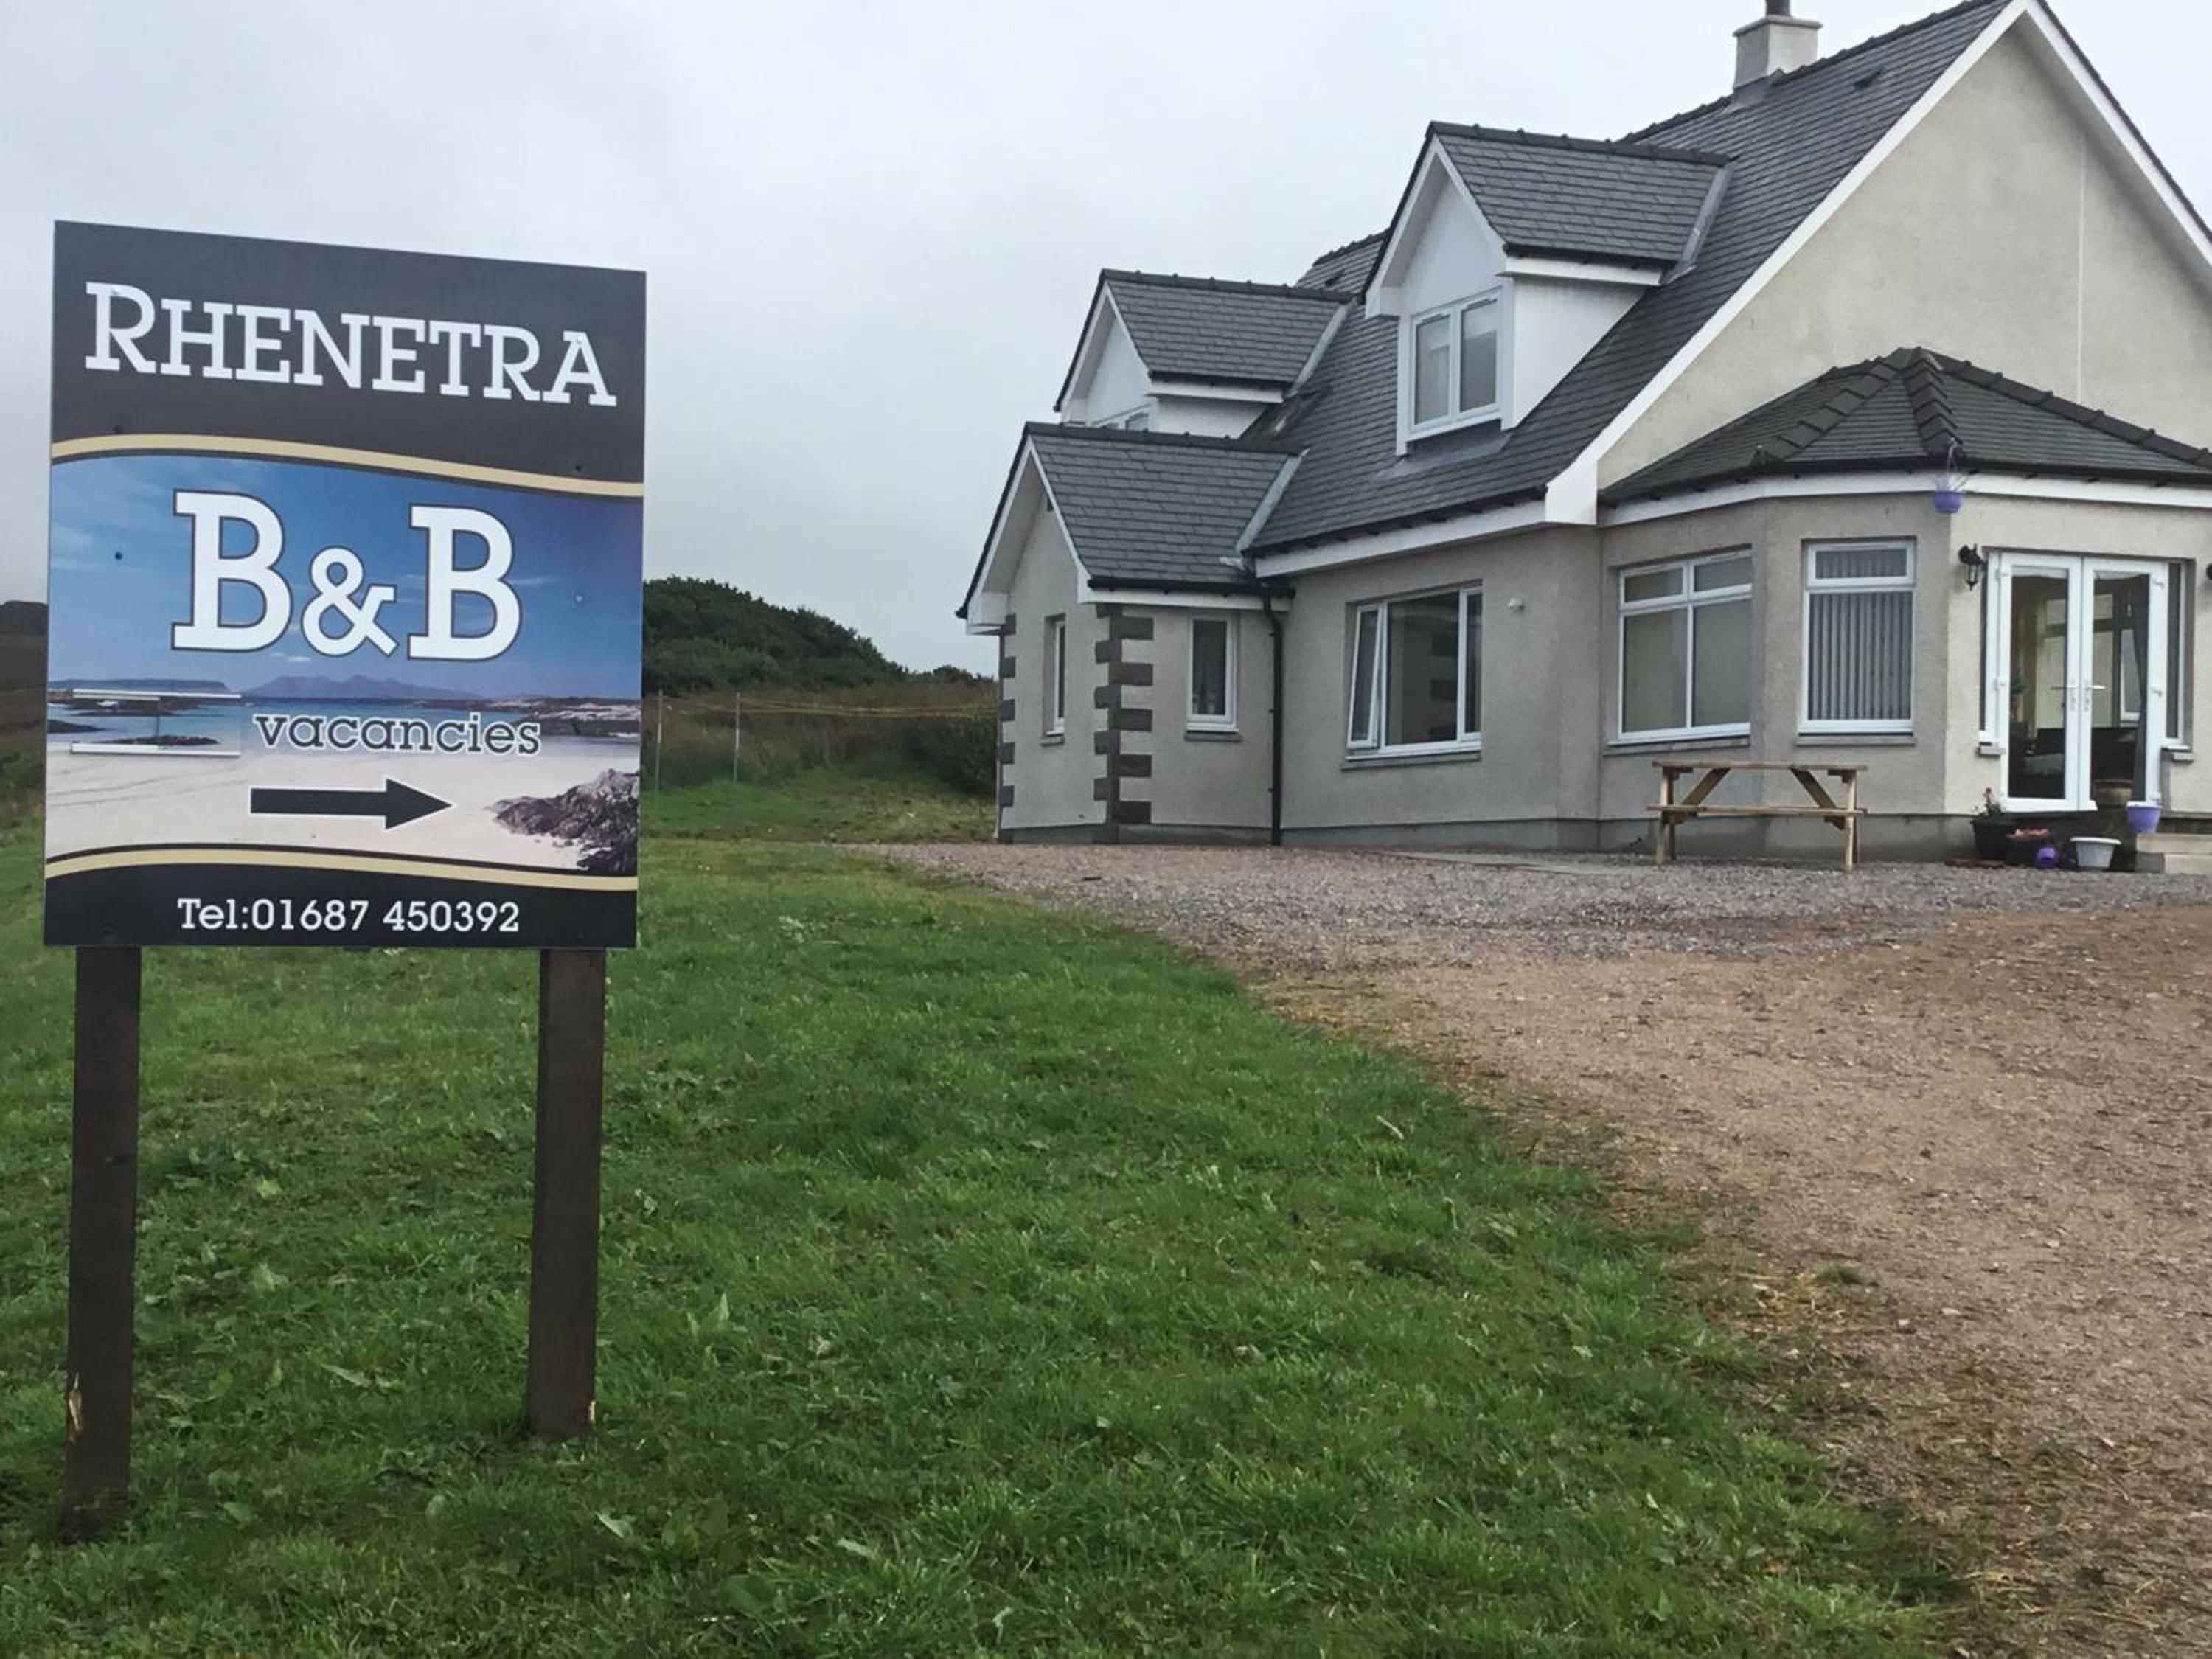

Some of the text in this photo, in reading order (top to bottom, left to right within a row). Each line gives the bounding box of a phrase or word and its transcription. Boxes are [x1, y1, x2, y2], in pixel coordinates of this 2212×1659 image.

[86, 281, 616, 406] RHENETRA
[171, 489, 521, 661] B&B
[253, 712, 540, 755] vacancies
[178, 897, 520, 933] Tel:01687 450392
